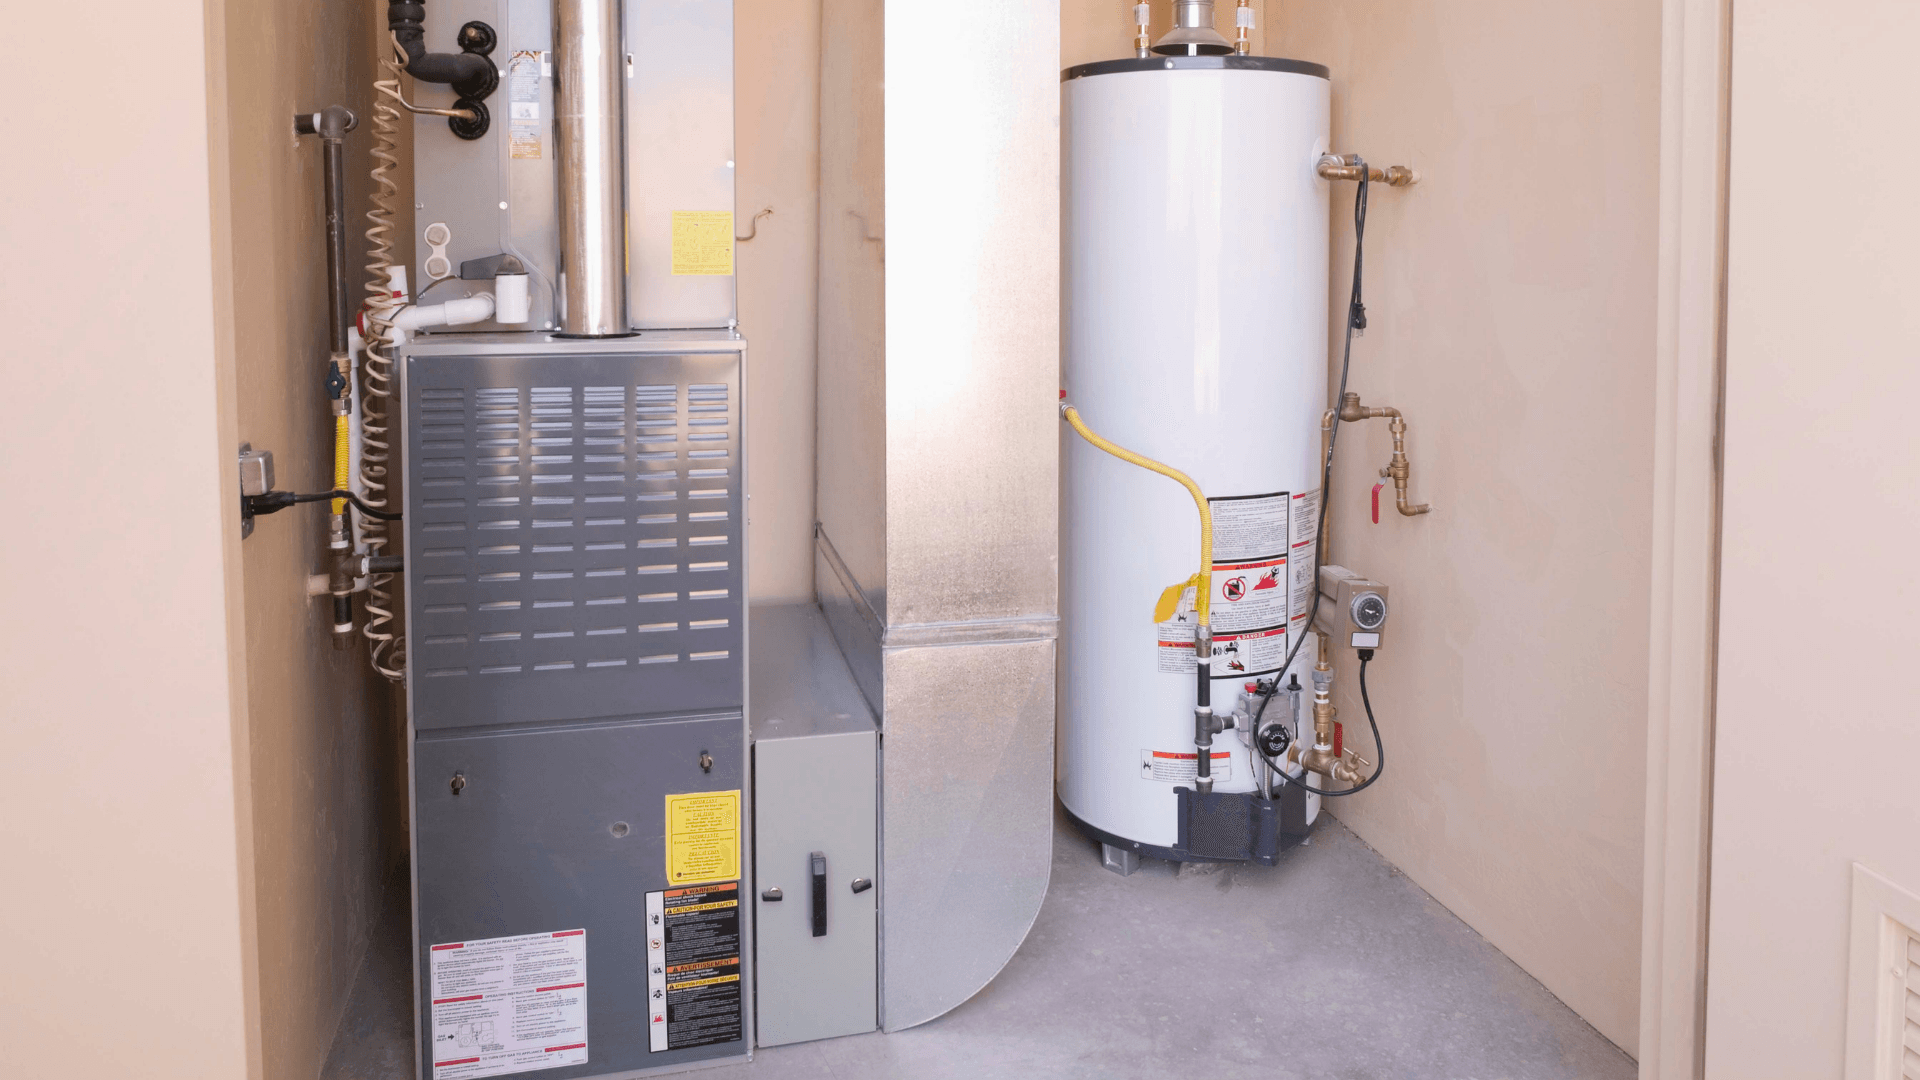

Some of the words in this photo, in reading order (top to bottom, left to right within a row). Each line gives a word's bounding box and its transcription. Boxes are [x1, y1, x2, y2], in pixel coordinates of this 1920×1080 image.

[1242, 632, 1266, 640] DANGER
[689, 886, 719, 894] WARNING
[680, 958, 732, 970] AVERTISSEMENT
